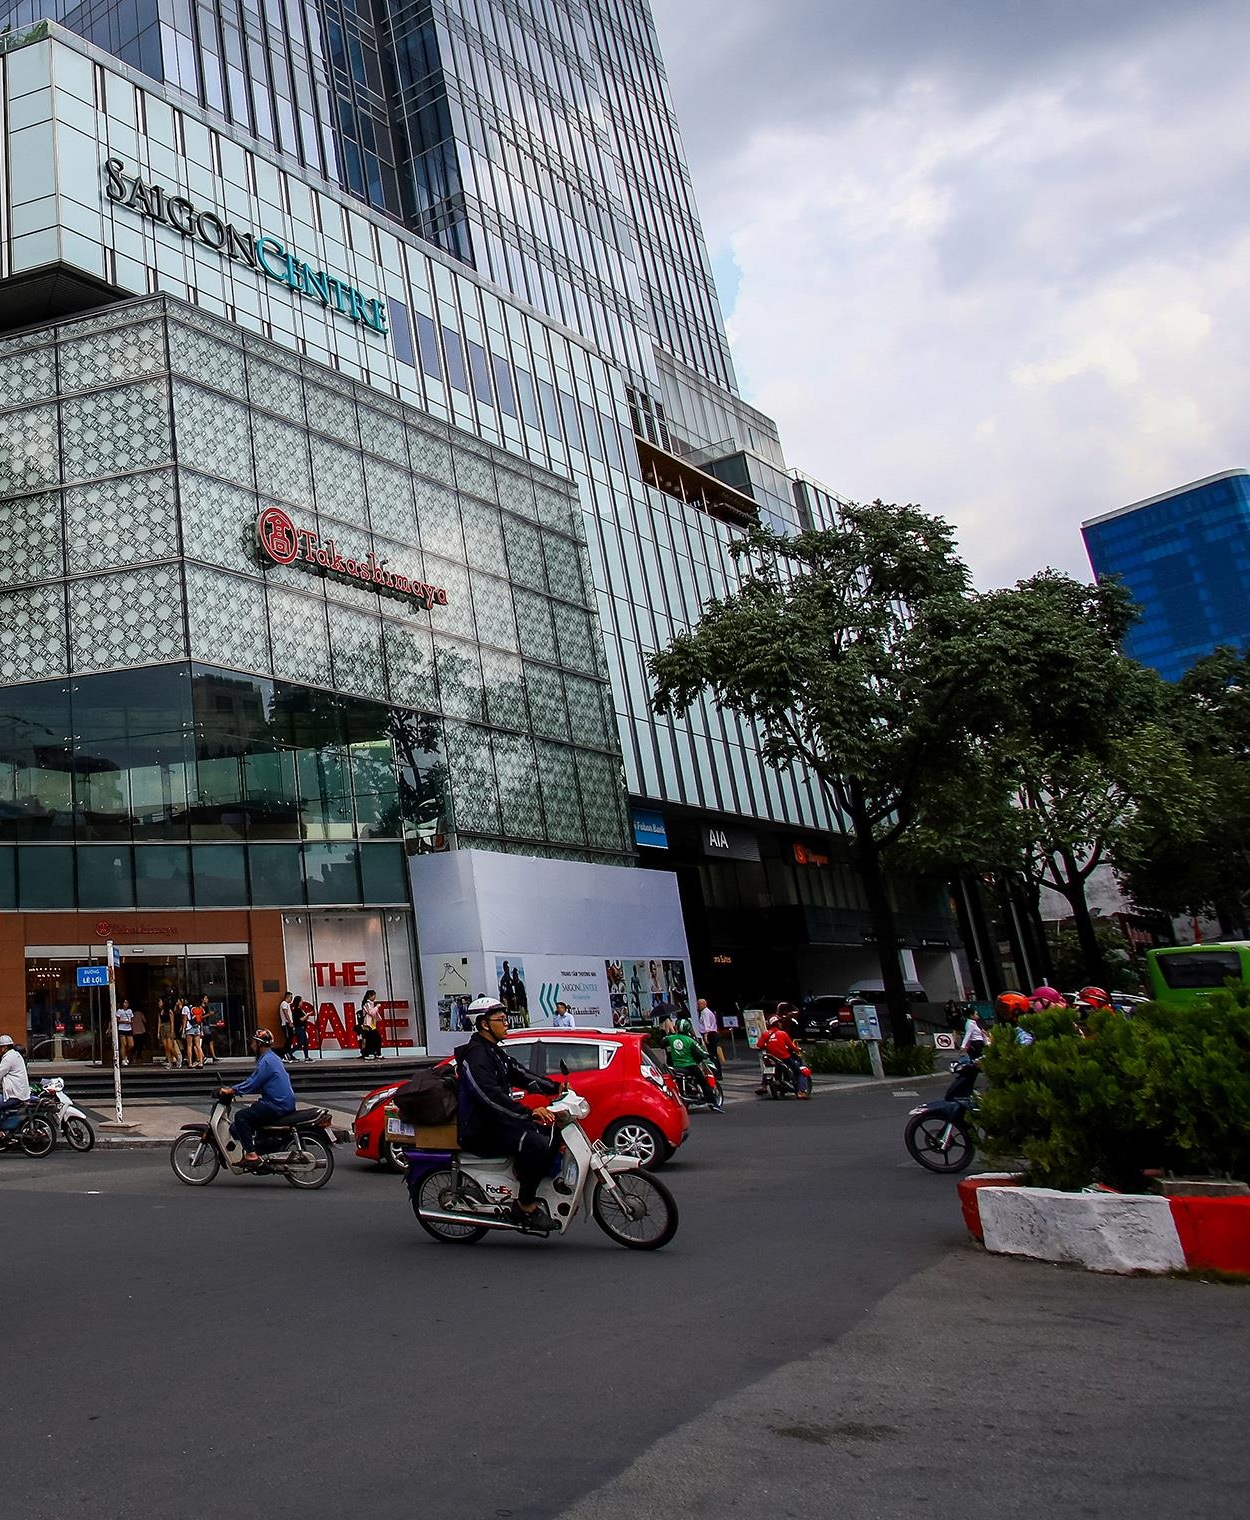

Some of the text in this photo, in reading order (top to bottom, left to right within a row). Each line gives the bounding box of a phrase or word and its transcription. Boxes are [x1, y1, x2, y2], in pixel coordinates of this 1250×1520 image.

[298, 528, 448, 610] Takashimaya
[710, 828, 729, 849] AIA
[311, 962, 368, 987] THE
[485, 1184, 512, 1195] FedEx
